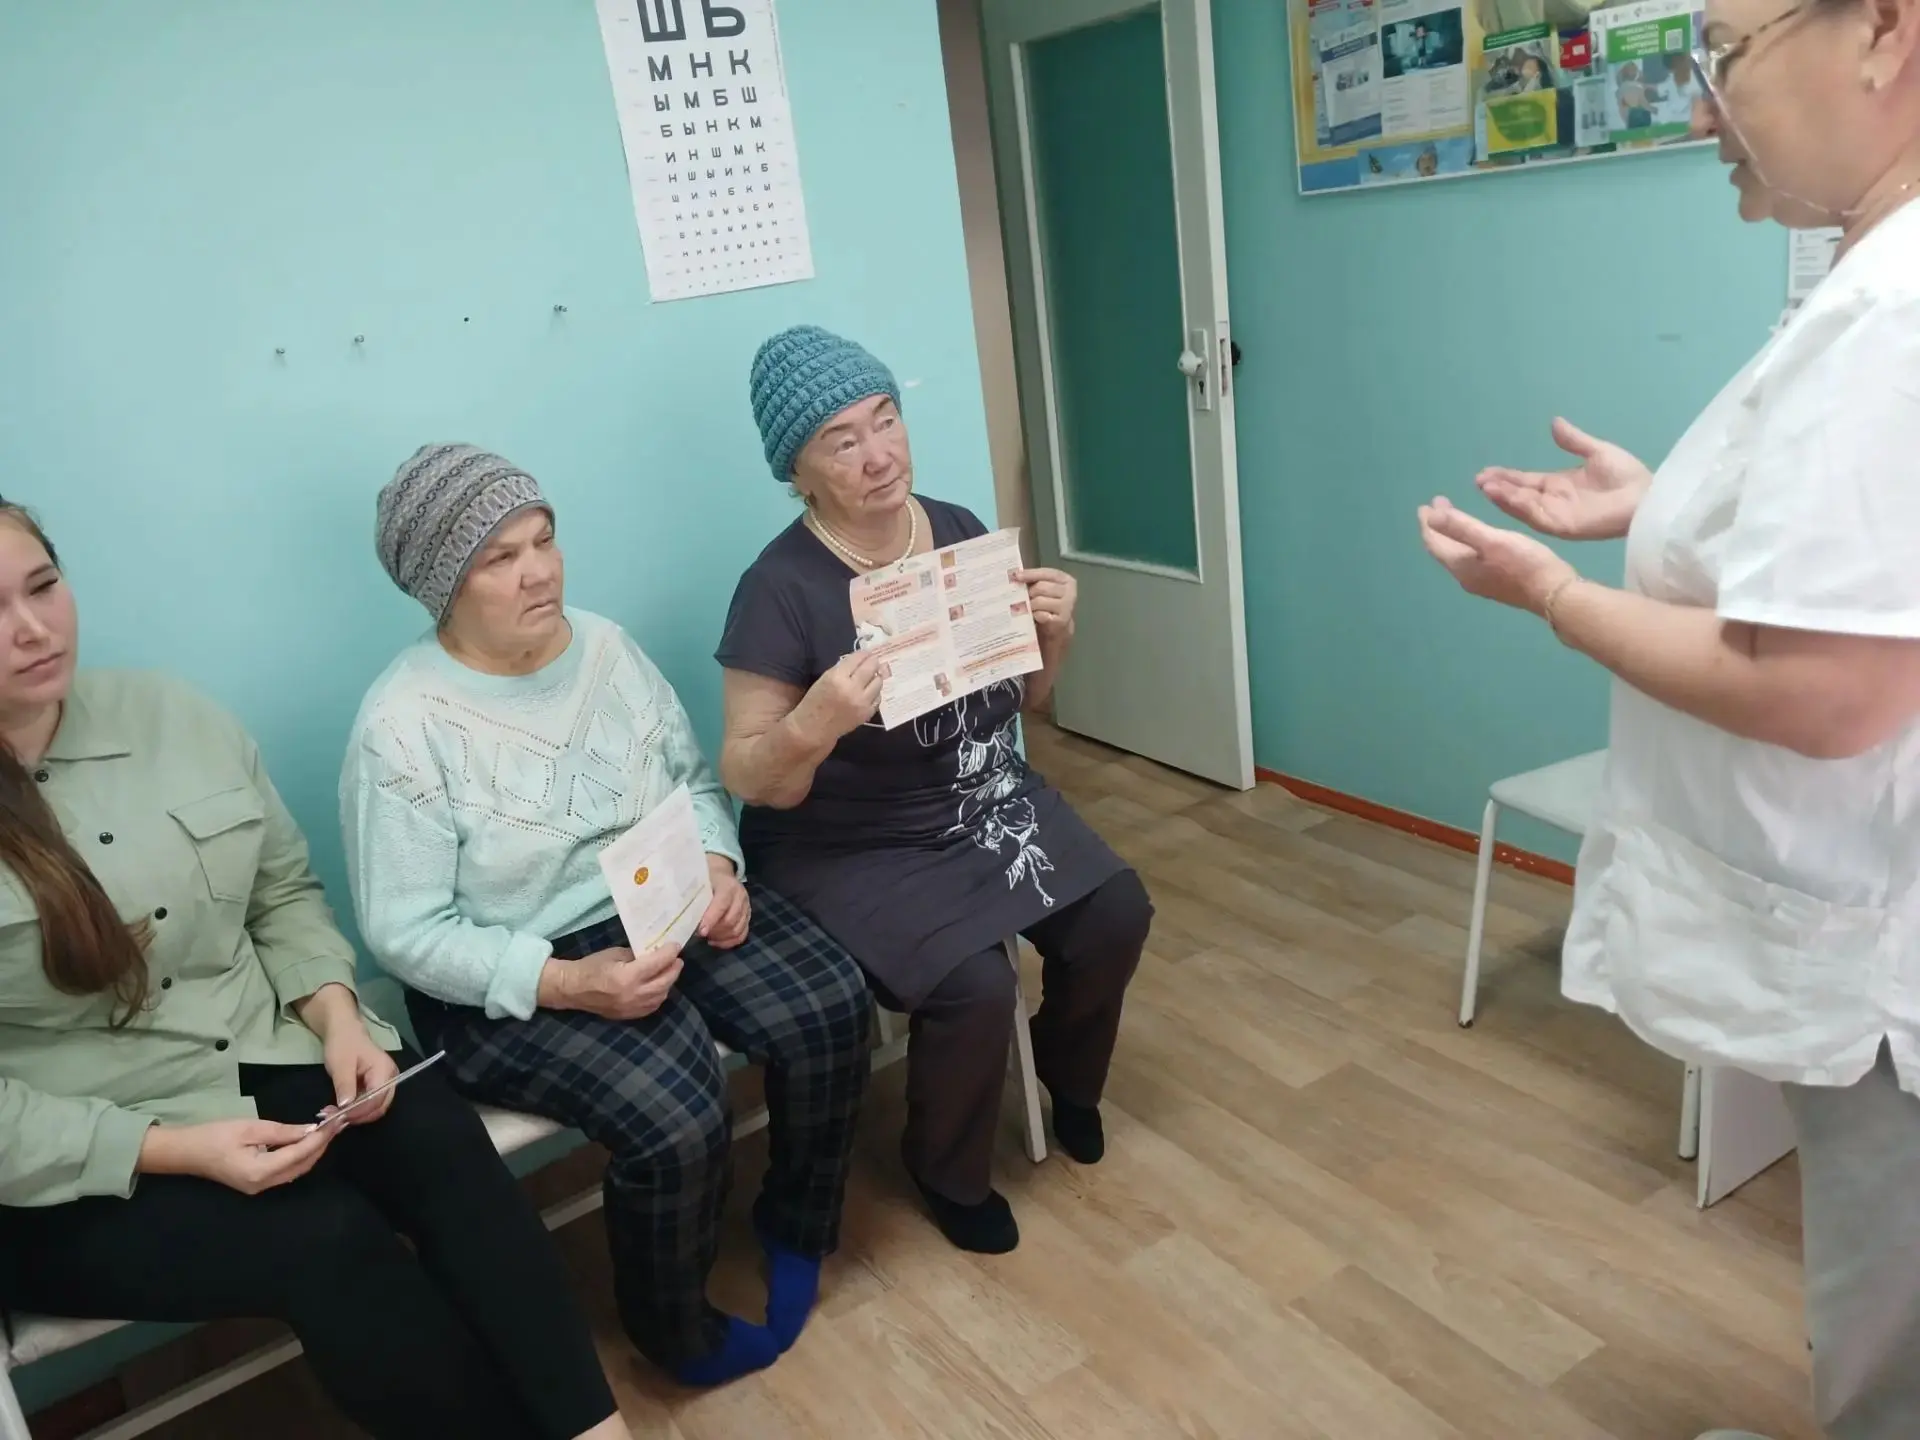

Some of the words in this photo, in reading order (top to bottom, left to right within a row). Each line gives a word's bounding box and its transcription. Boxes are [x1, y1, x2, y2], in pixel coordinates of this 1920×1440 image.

[636, 0, 687, 43] Ш
[647, 55, 672, 82] М
[689, 52, 713, 78] Н
[728, 49, 751, 75] К
[654, 94, 670, 111] Ы
[684, 91, 700, 109] М
[713, 89, 728, 106] Б
[741, 86, 757, 103] Ш
[659, 123, 673, 139] Б
[682, 121, 697, 137] Ы
[705, 119, 719, 134] Н
[726, 116, 741, 132] К
[749, 115, 763, 129] М
[664, 151, 677, 164] И
[687, 148, 700, 161] Н
[710, 146, 722, 159] Ш
[733, 144, 744, 157] М
[755, 141, 766, 154] К
[668, 172, 678, 184] Н
[687, 171, 697, 182] Ш
[724, 167, 733, 177] И
[760, 162, 769, 173] Б
[727, 186, 736, 196] Б
